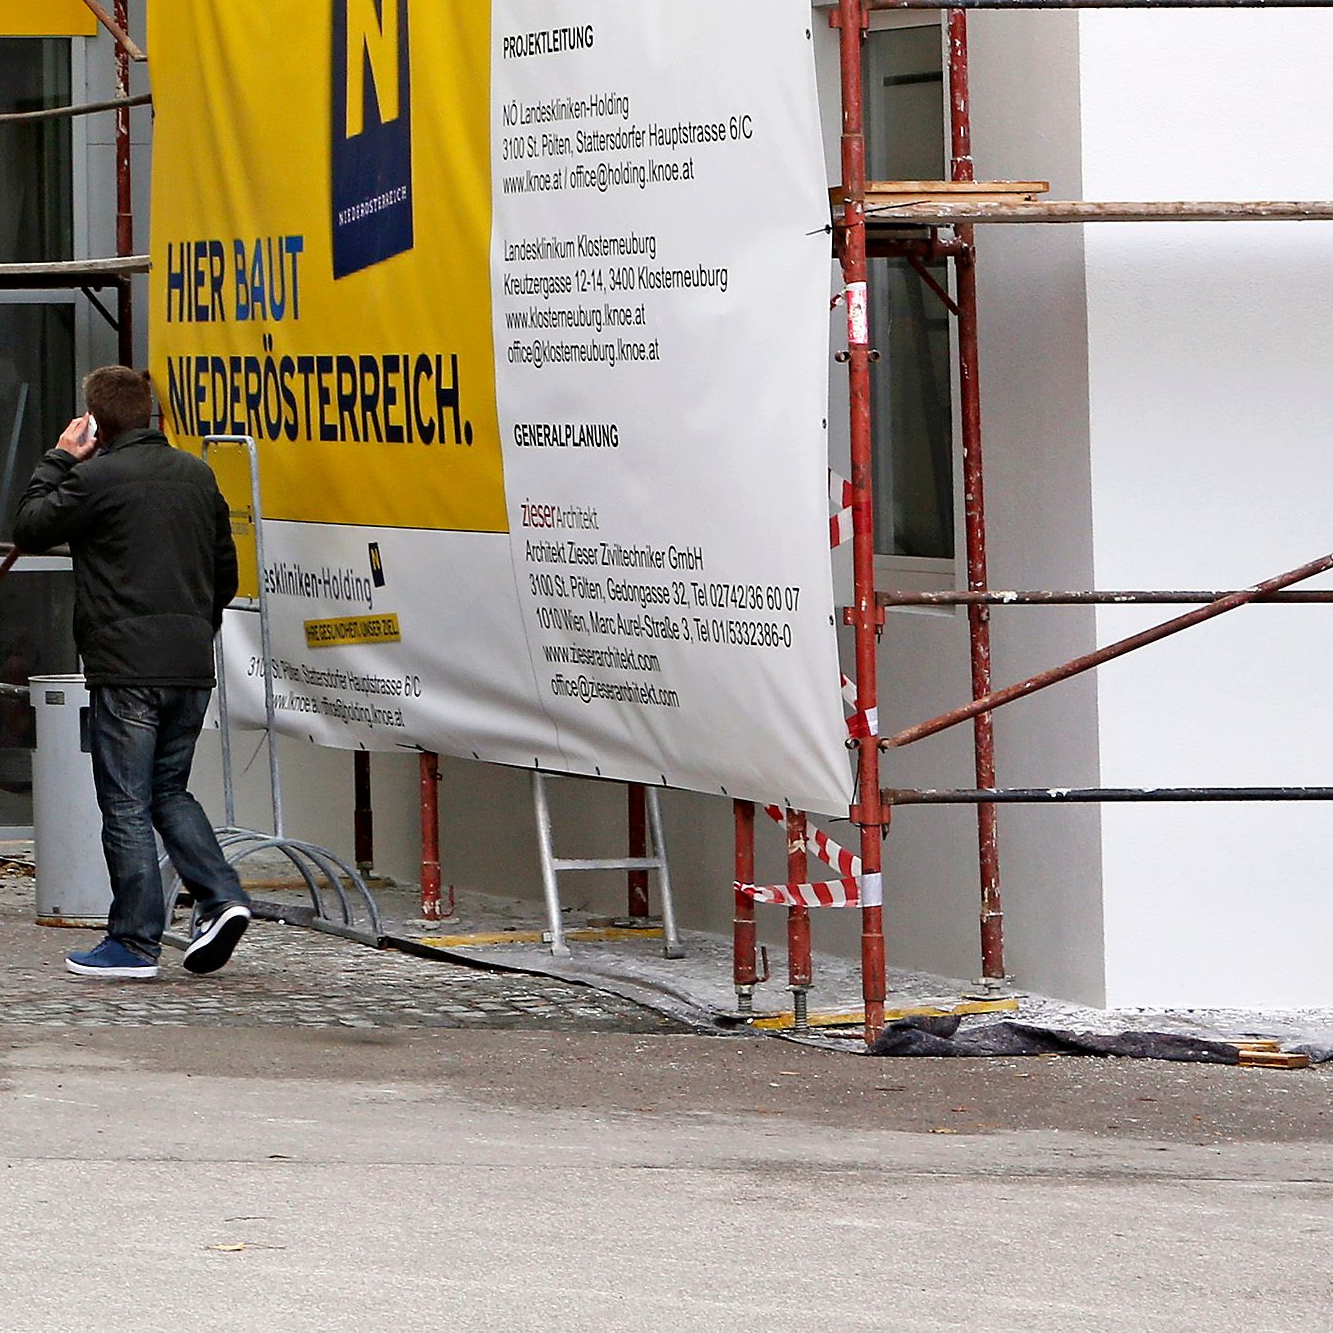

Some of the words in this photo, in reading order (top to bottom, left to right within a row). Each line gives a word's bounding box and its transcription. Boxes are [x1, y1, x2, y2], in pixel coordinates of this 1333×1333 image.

[503, 25, 593, 59] PROJEKTLEITUNG
[503, 99, 517, 126] NÖ
[520, 92, 629, 125] Landeskliniken-Holding
[503, 137, 524, 161] 3100
[527, 134, 539, 159] St.
[542, 131, 573, 157] Pölten,
[576, 125, 646, 154] Stattersdorfer
[649, 120, 726, 150] Hauptstrasse
[729, 115, 753, 141] 6/C
[570, 157, 694, 192] office@holding.lknoe.at
[505, 236, 575, 262] Landesklinikum
[577, 232, 656, 259] Klosterneuburg
[167, 241, 225, 322] HIER
[233, 235, 304, 321] BAUT
[504, 273, 571, 299] Kreutzergasse
[575, 269, 607, 295] 12-14,
[609, 267, 635, 291] 3400
[638, 264, 728, 292] Klosterneuburg
[505, 303, 645, 332] www.klosterneuburg.lknoe.at
[508, 338, 659, 368] office@klosterneuburg.lknoe.at
[167, 333, 473, 446] NIEDERÖSTERREICH.
[514, 423, 619, 447] GENERALPLANUNG
[526, 539, 565, 564] Architekt
[567, 541, 598, 565] Zieser
[600, 543, 666, 569] Ziviltechniker
[669, 545, 703, 571] GmbH
[529, 573, 553, 597] 3100
[555, 575, 568, 597] St.
[571, 575, 606, 603] Pölten,
[607, 577, 669, 609] Gedongasse
[672, 581, 690, 609] 32,
[691, 582, 708, 607] Tel
[710, 583, 763, 610] 02742/36
[767, 586, 782, 610] 60
[785, 587, 800, 611] 07
[536, 607, 561, 630] 1010
[562, 609, 589, 636] Wien,
[591, 611, 615, 635] Marc
[617, 613, 679, 639] Aurel-Straße
[694, 619, 710, 643] Tel
[712, 620, 792, 648] 01/5332386-0
[543, 643, 661, 672] www.zieserarchitekt.com
[247, 656, 265, 677] 310
[348, 670, 402, 697] Hauptstrasse
[551, 673, 680, 708] office@zieserarchitekt.com
